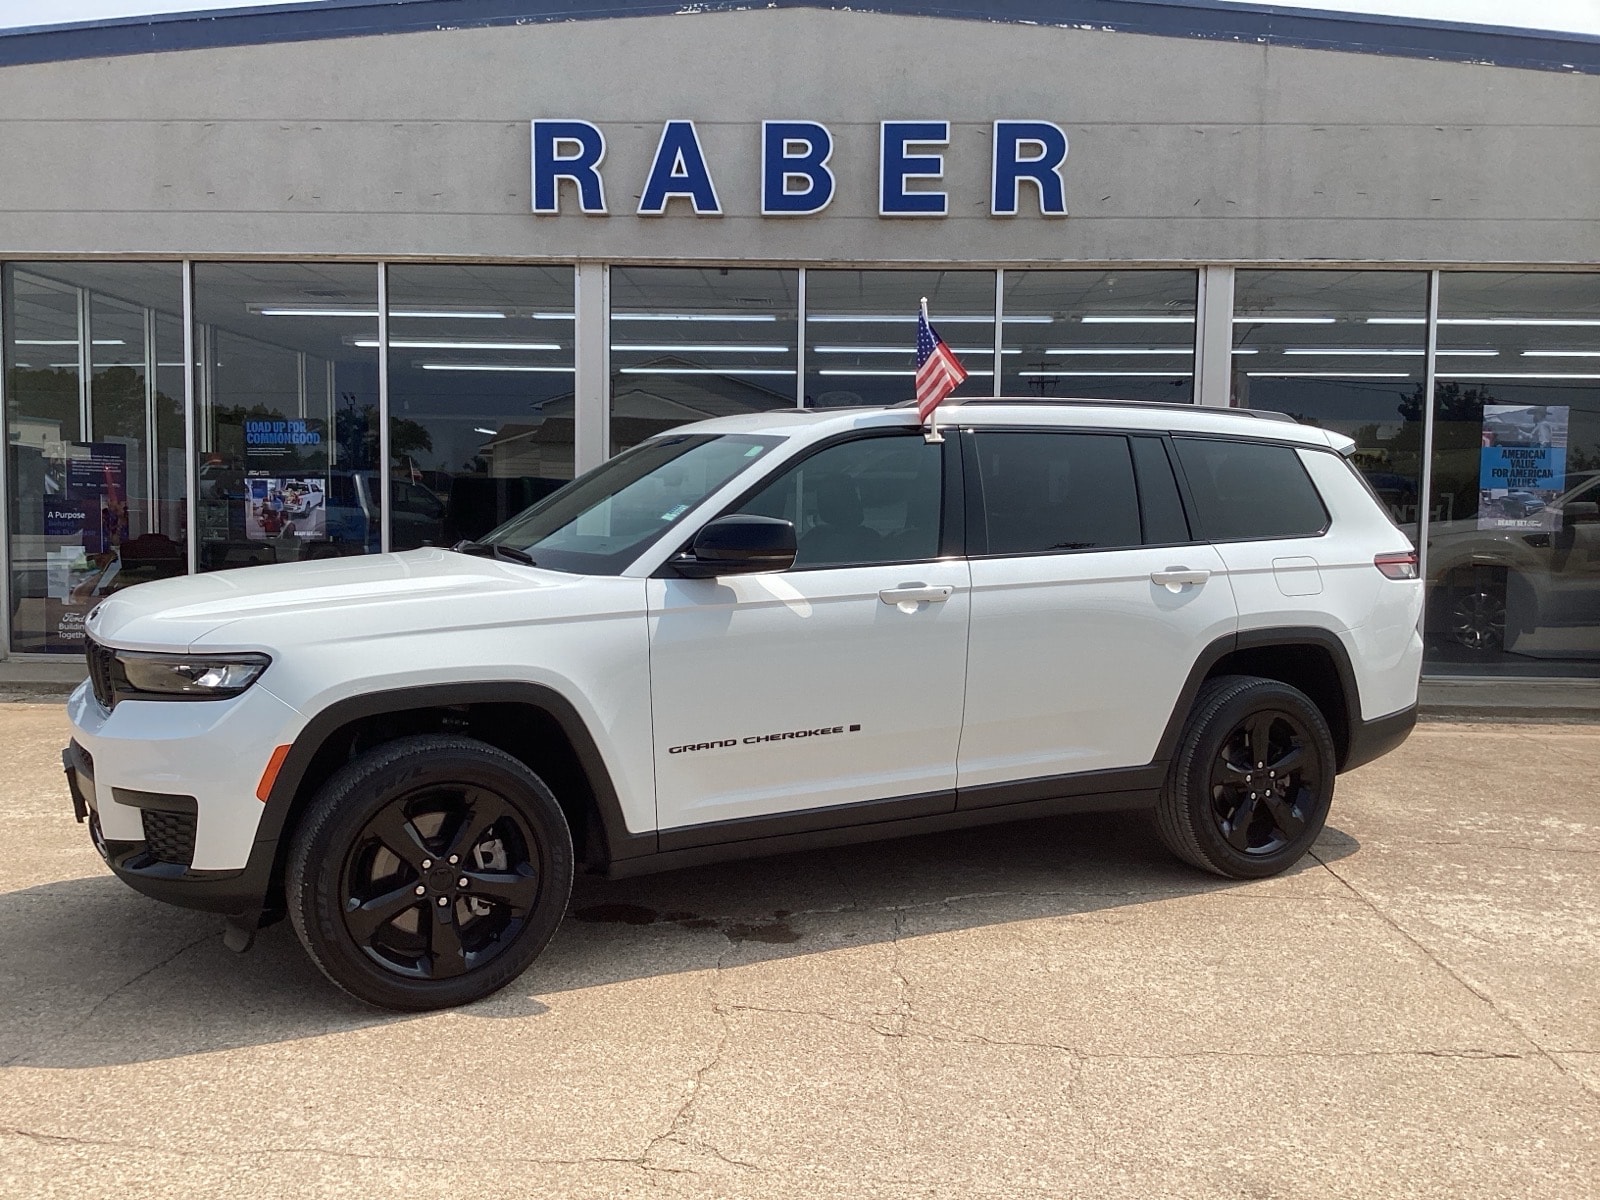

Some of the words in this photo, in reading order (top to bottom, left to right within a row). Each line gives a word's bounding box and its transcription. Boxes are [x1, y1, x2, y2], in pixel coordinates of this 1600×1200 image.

[531, 119, 1070, 218] RABER
[246, 422, 271, 433] LOAD
[273, 421, 287, 433] UP
[288, 422, 307, 433] FOR
[246, 433, 292, 444] COMMON
[292, 433, 321, 444] GOOD
[1502, 450, 1546, 459] AMERICAN
[1510, 459, 1538, 469] VALUE.
[1492, 468, 1509, 478] FOR
[1509, 469, 1554, 478] AMERICAN
[1506, 478, 1540, 488] VALUES.
[47, 511, 54, 519] A
[55, 511, 86, 520] Purpose
[62, 612, 85, 623] Ford
[58, 622, 85, 631] Buildin
[57, 631, 85, 640] Togeth
[668, 739, 737, 754] GRAND
[742, 726, 844, 745] CHEROKEE
